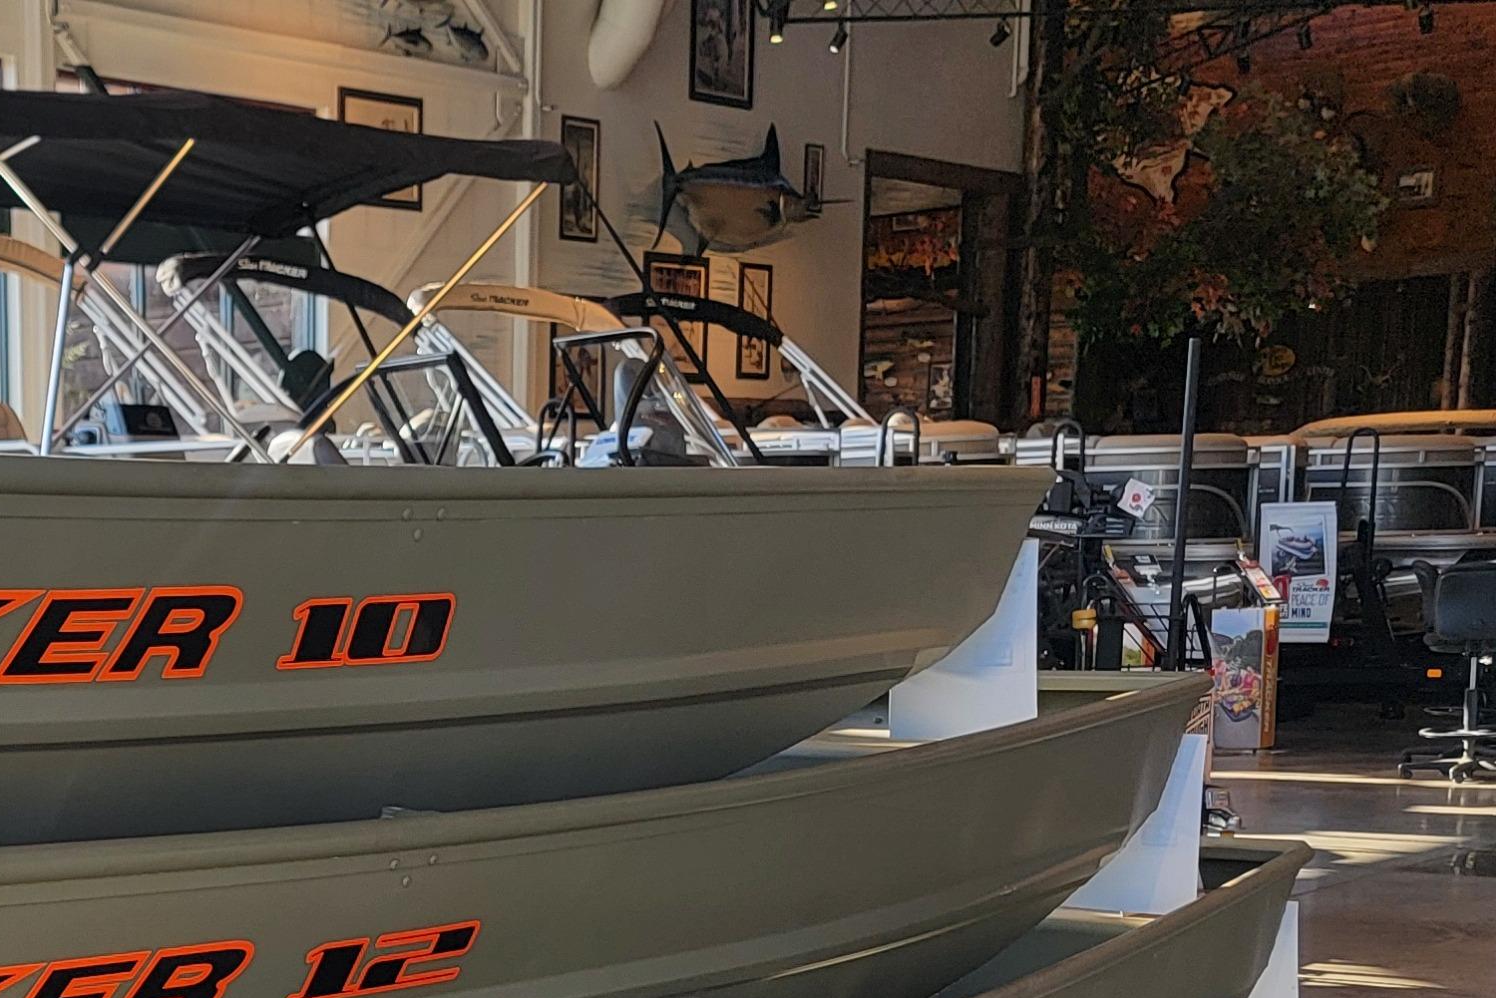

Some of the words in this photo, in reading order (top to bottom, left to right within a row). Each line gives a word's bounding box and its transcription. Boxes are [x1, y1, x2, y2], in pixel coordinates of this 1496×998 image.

[1054, 521, 1078, 531] KOTA
[1291, 593, 1316, 607] PEACE
[1319, 593, 1331, 606] OF
[1291, 607, 1312, 618] MIND
[275, 592, 457, 671] 10
